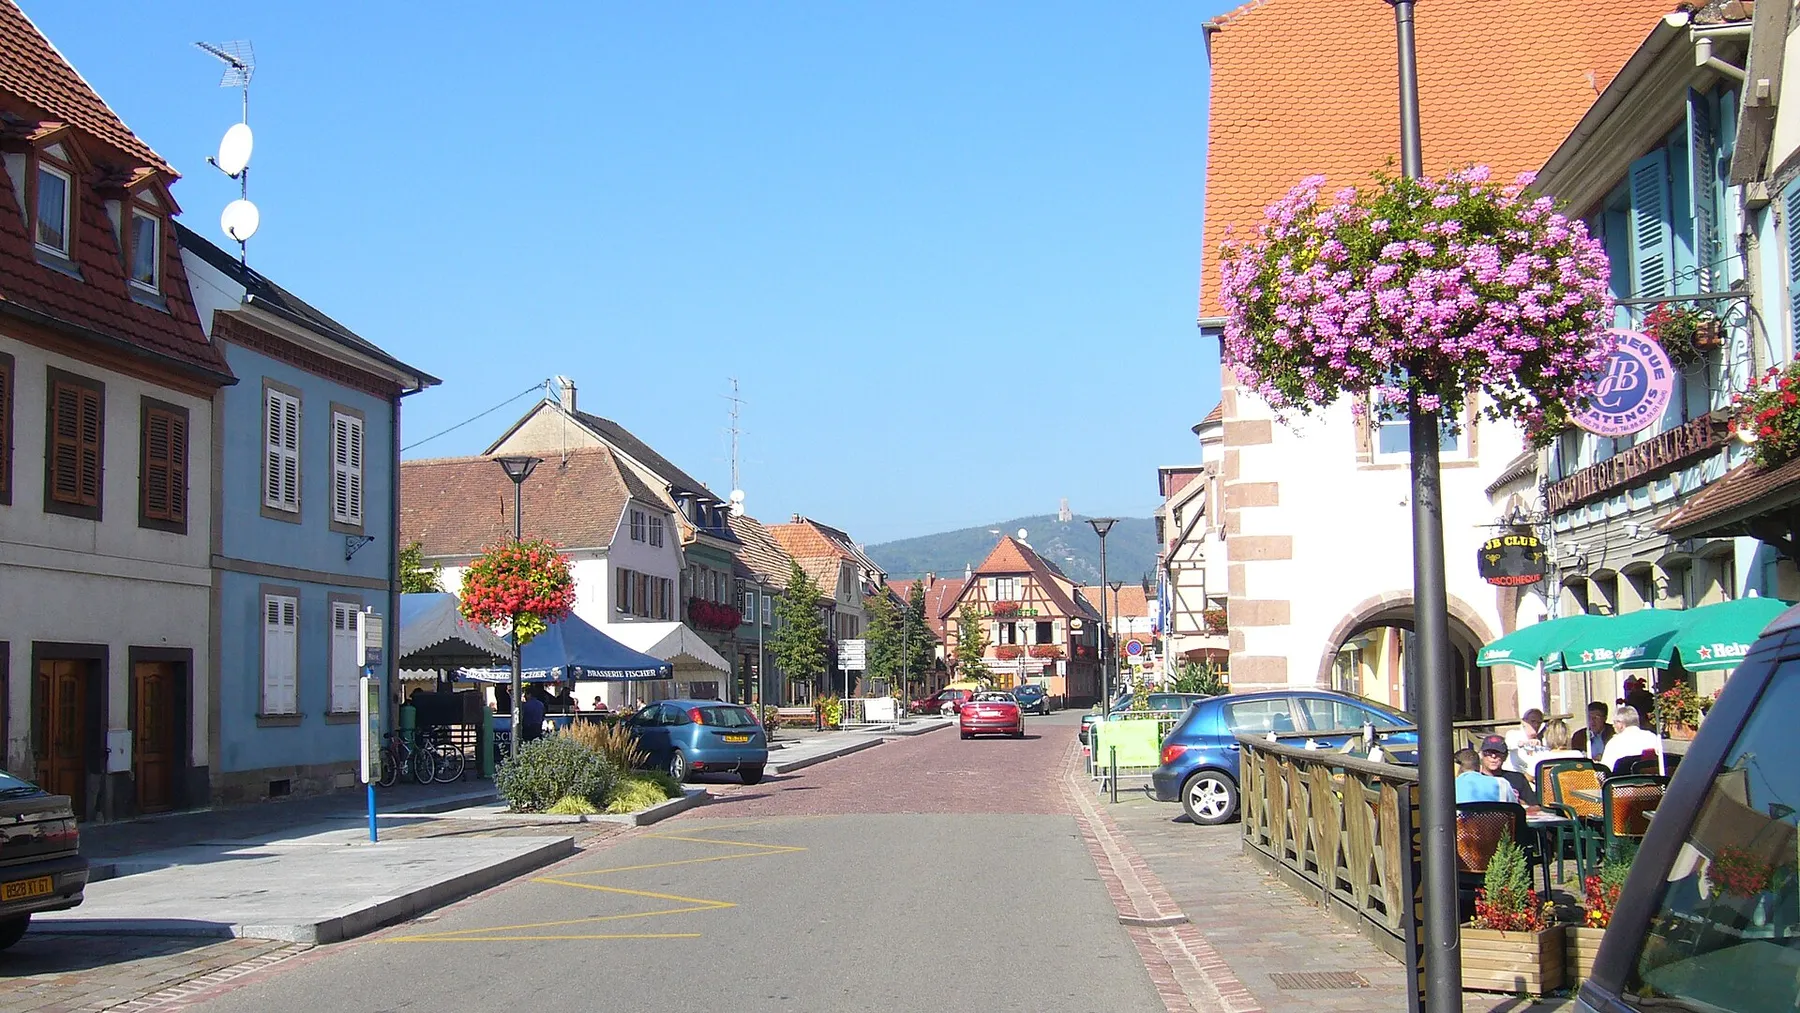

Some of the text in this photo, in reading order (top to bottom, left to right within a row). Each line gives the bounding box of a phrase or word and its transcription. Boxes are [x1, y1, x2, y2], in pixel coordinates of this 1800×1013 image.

[1589, 388, 1658, 425] ATENOIS
[1485, 535, 1538, 550] JB CLUB
[1488, 574, 1541, 586] DISCOTHEQUE
[736, 580, 744, 615] HOTEL
[1711, 642, 1751, 658] Hein
[587, 668, 656, 678] BRASSERIE FISCHER
[39, 878, 48, 892] 67
